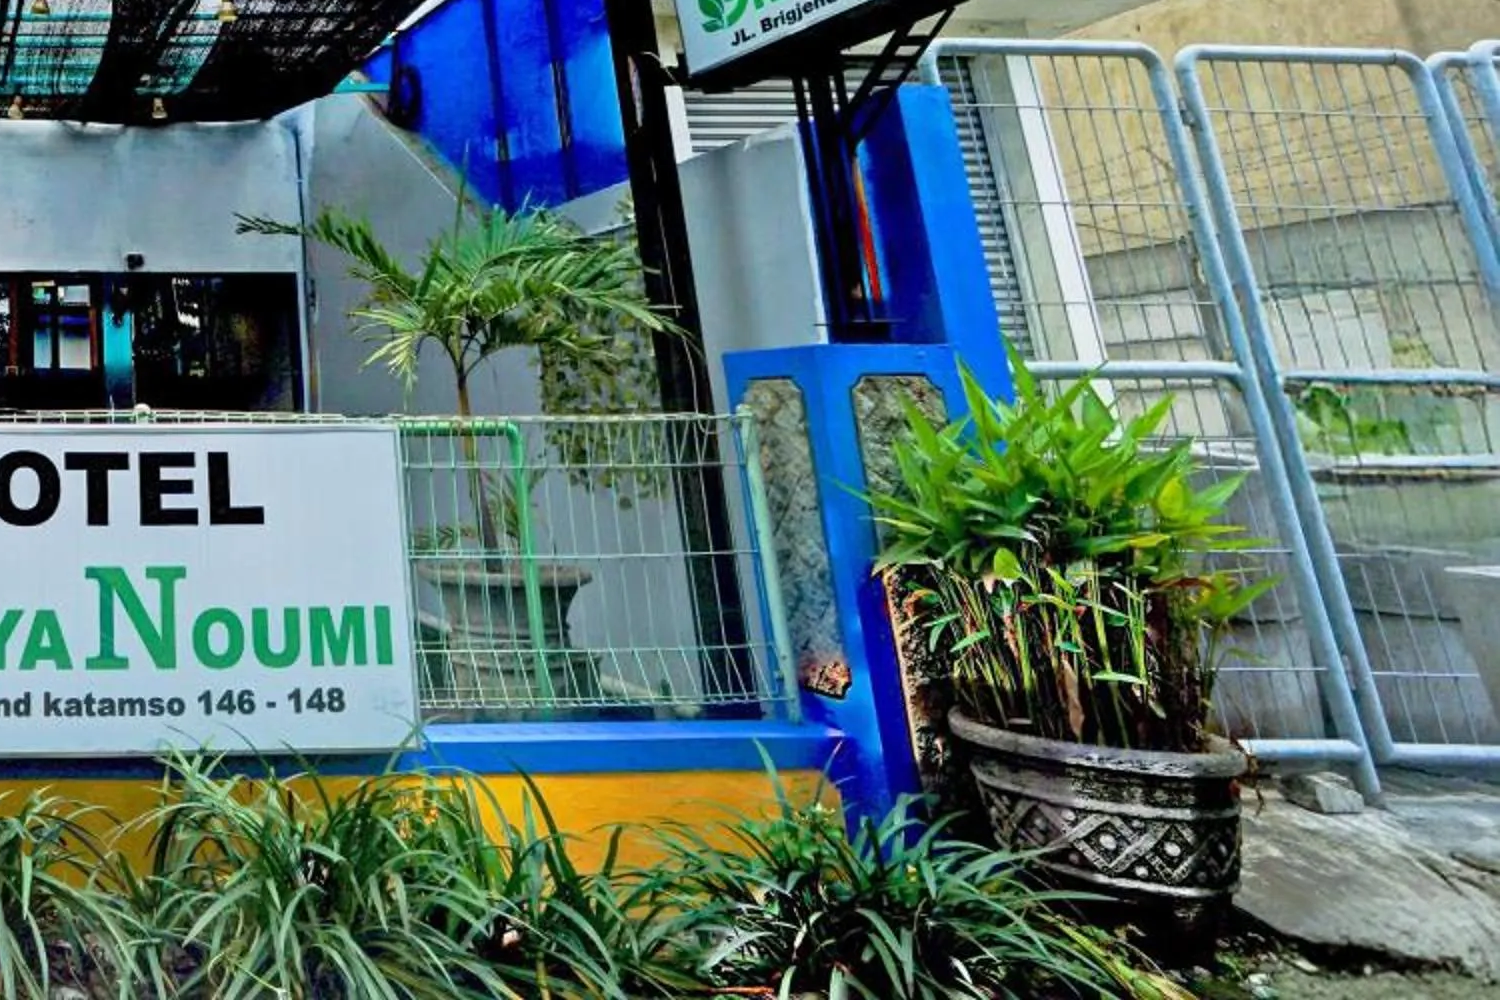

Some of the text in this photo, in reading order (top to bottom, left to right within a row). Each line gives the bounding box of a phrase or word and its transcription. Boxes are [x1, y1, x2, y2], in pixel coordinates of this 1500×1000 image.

[731, 28, 757, 47] JL.
[84, 566, 394, 671] NOUMI
[43, 691, 186, 717] katamso
[196, 689, 256, 715] 146
[287, 687, 347, 713] 148
